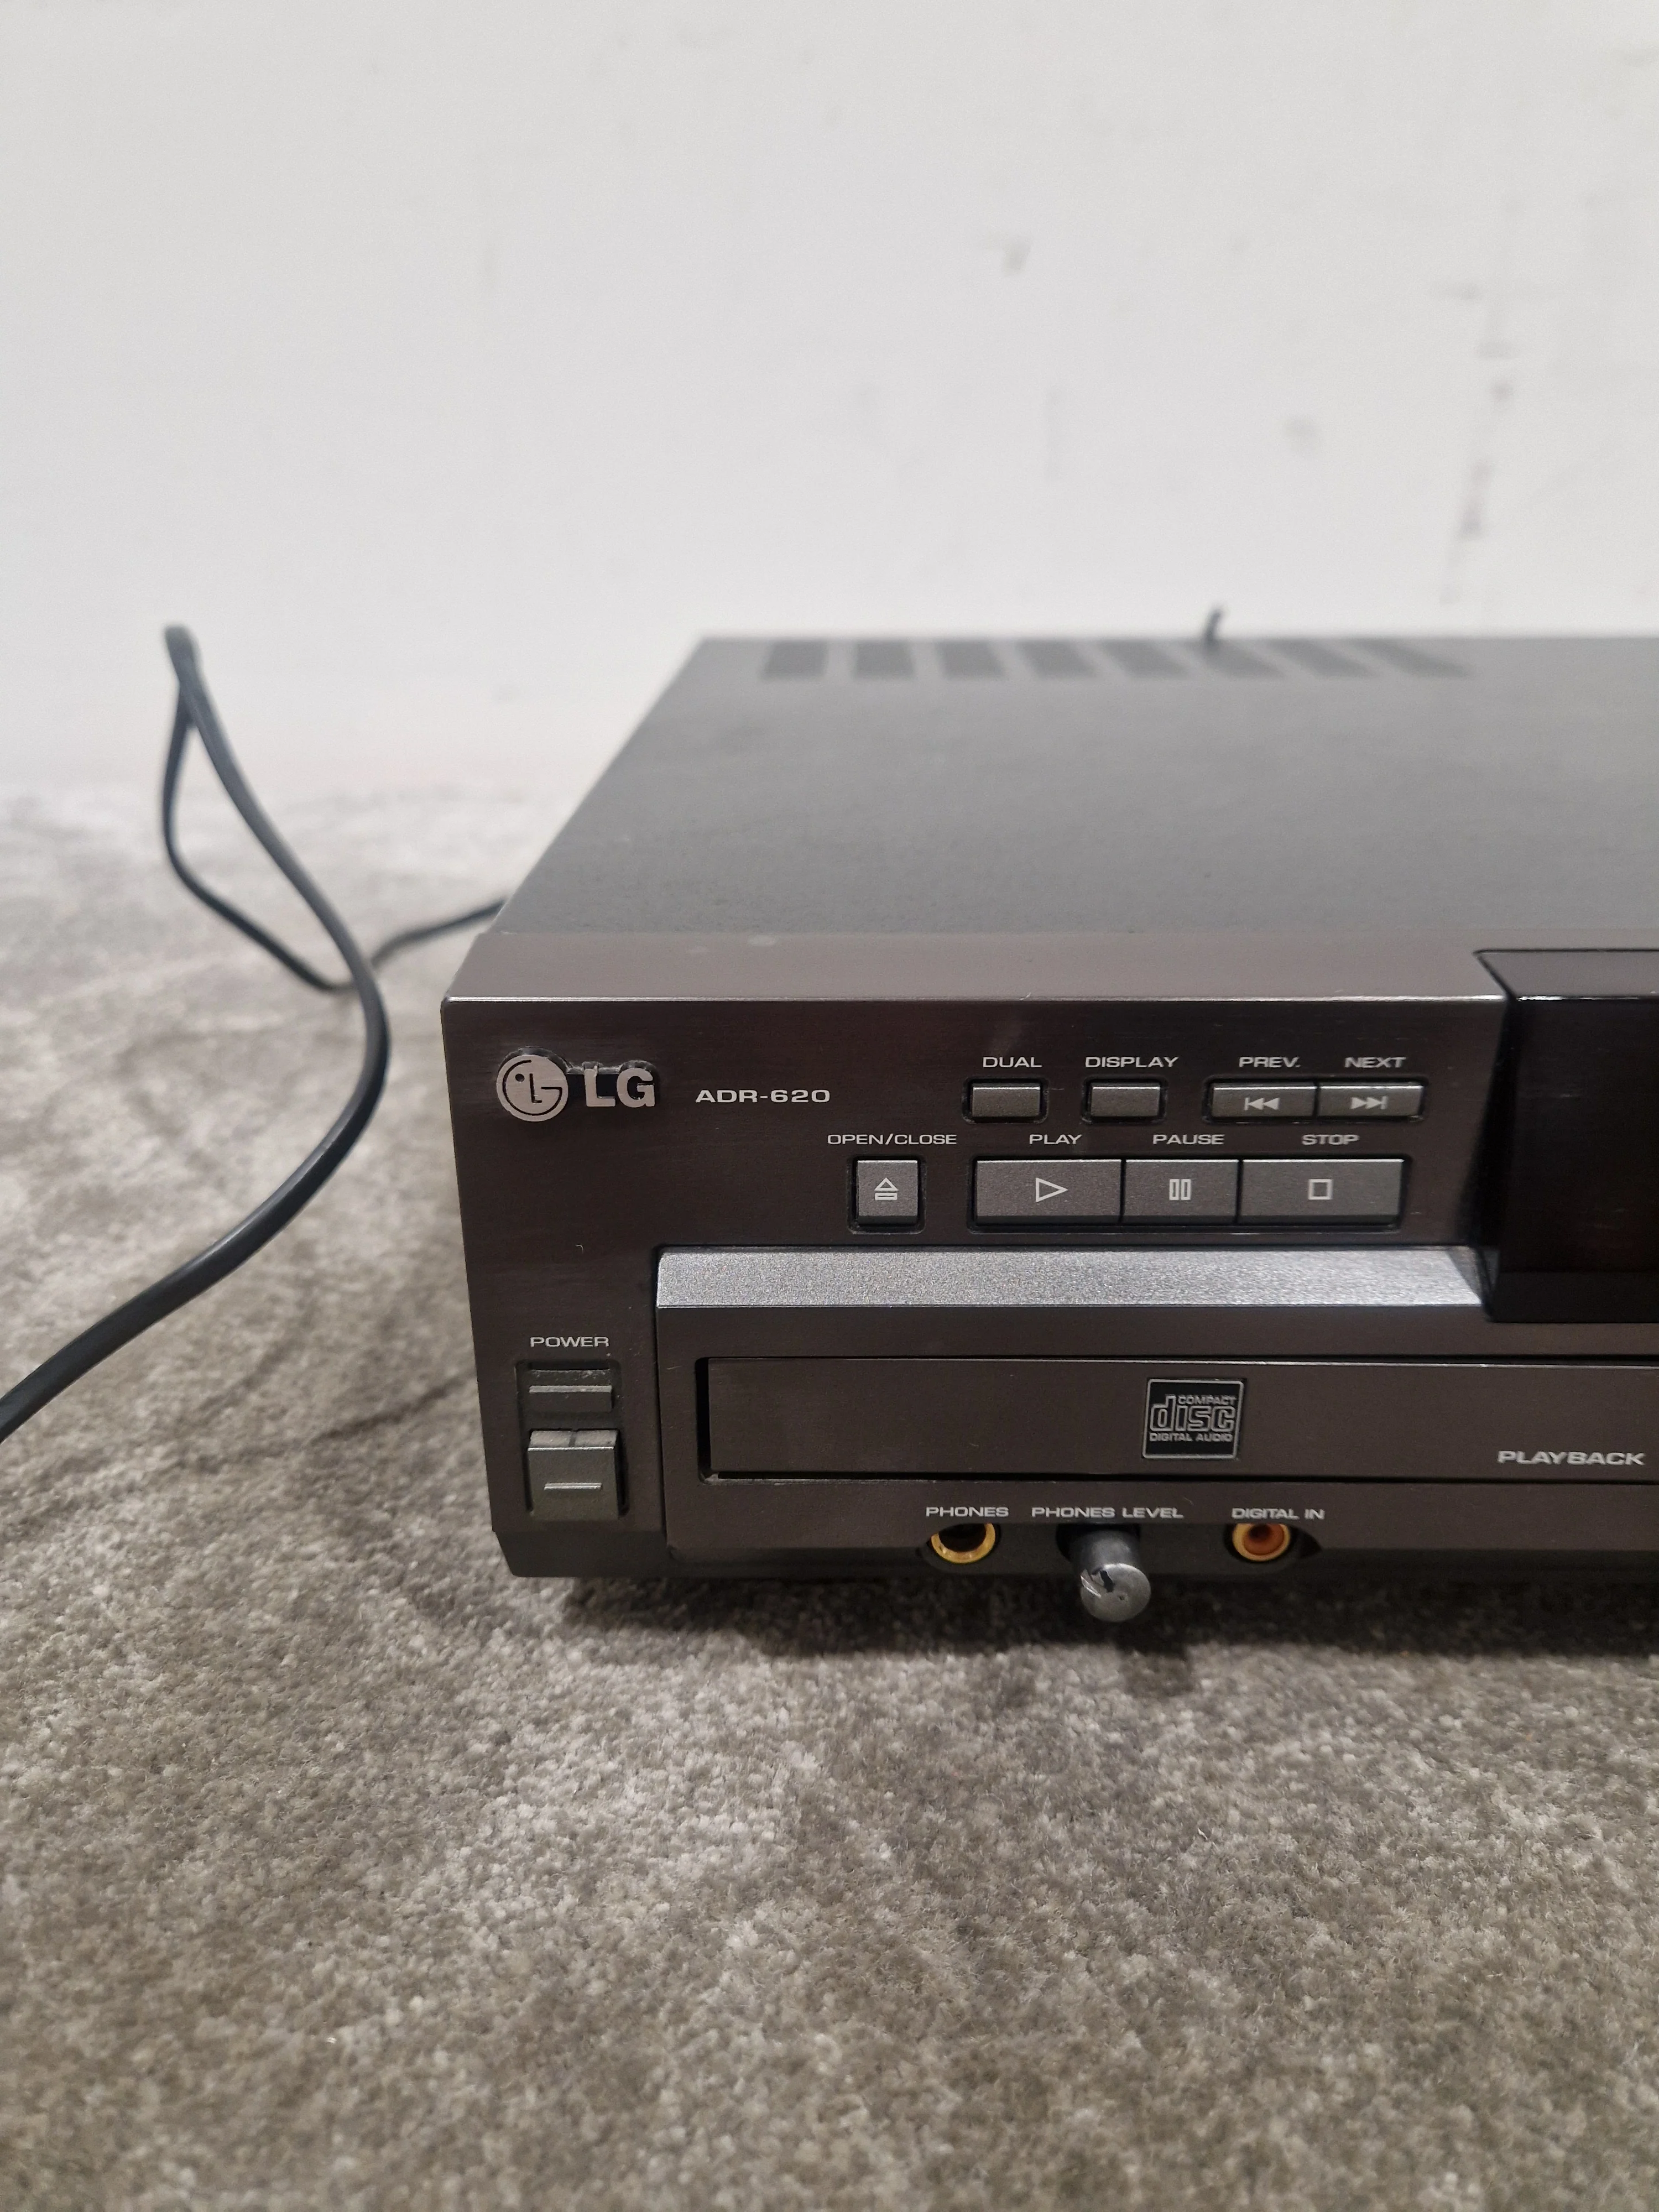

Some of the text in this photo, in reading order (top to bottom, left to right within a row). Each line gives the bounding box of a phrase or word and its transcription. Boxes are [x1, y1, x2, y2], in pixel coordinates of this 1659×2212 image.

[982, 1057, 1042, 1068] DUAL
[1084, 1057, 1179, 1068] DISPLAY
[1238, 1056, 1301, 1068] PREV.
[1344, 1057, 1407, 1068] NEXT
[584, 1068, 656, 1108] LG
[695, 1089, 831, 1104] ADR-620
[827, 1133, 958, 1145] OPEN/CLOSE
[1029, 1134, 1083, 1145] PLAY
[1152, 1134, 1225, 1145] PAUSE
[1301, 1134, 1360, 1145] STOP
[529, 1336, 609, 1348] POWER
[1177, 1395, 1237, 1406] COMPACT
[1150, 1394, 1237, 1432] disc
[1149, 1432, 1233, 1443] DIGITAL AUDIO
[1497, 1451, 1646, 1466] PLAYBACK
[926, 1506, 1009, 1517] PHONES
[1031, 1507, 1184, 1519] PHONES LEVEL
[1232, 1507, 1326, 1520] DIGITAL IN
